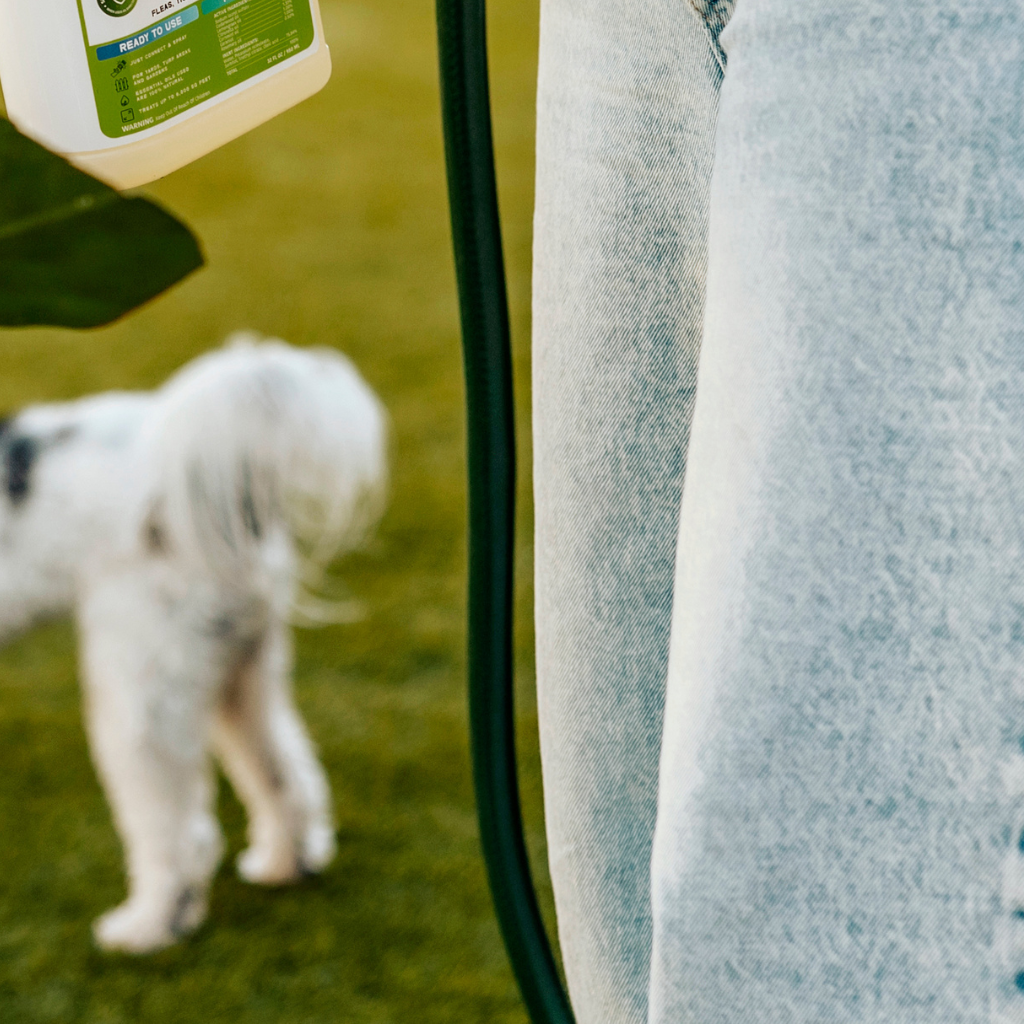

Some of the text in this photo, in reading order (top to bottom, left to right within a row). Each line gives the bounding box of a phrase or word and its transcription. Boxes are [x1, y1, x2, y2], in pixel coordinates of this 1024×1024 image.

[151, 1, 175, 17] FLEAS,
[119, 16, 183, 53] READY TO USE
[121, 117, 154, 133] WARNING
